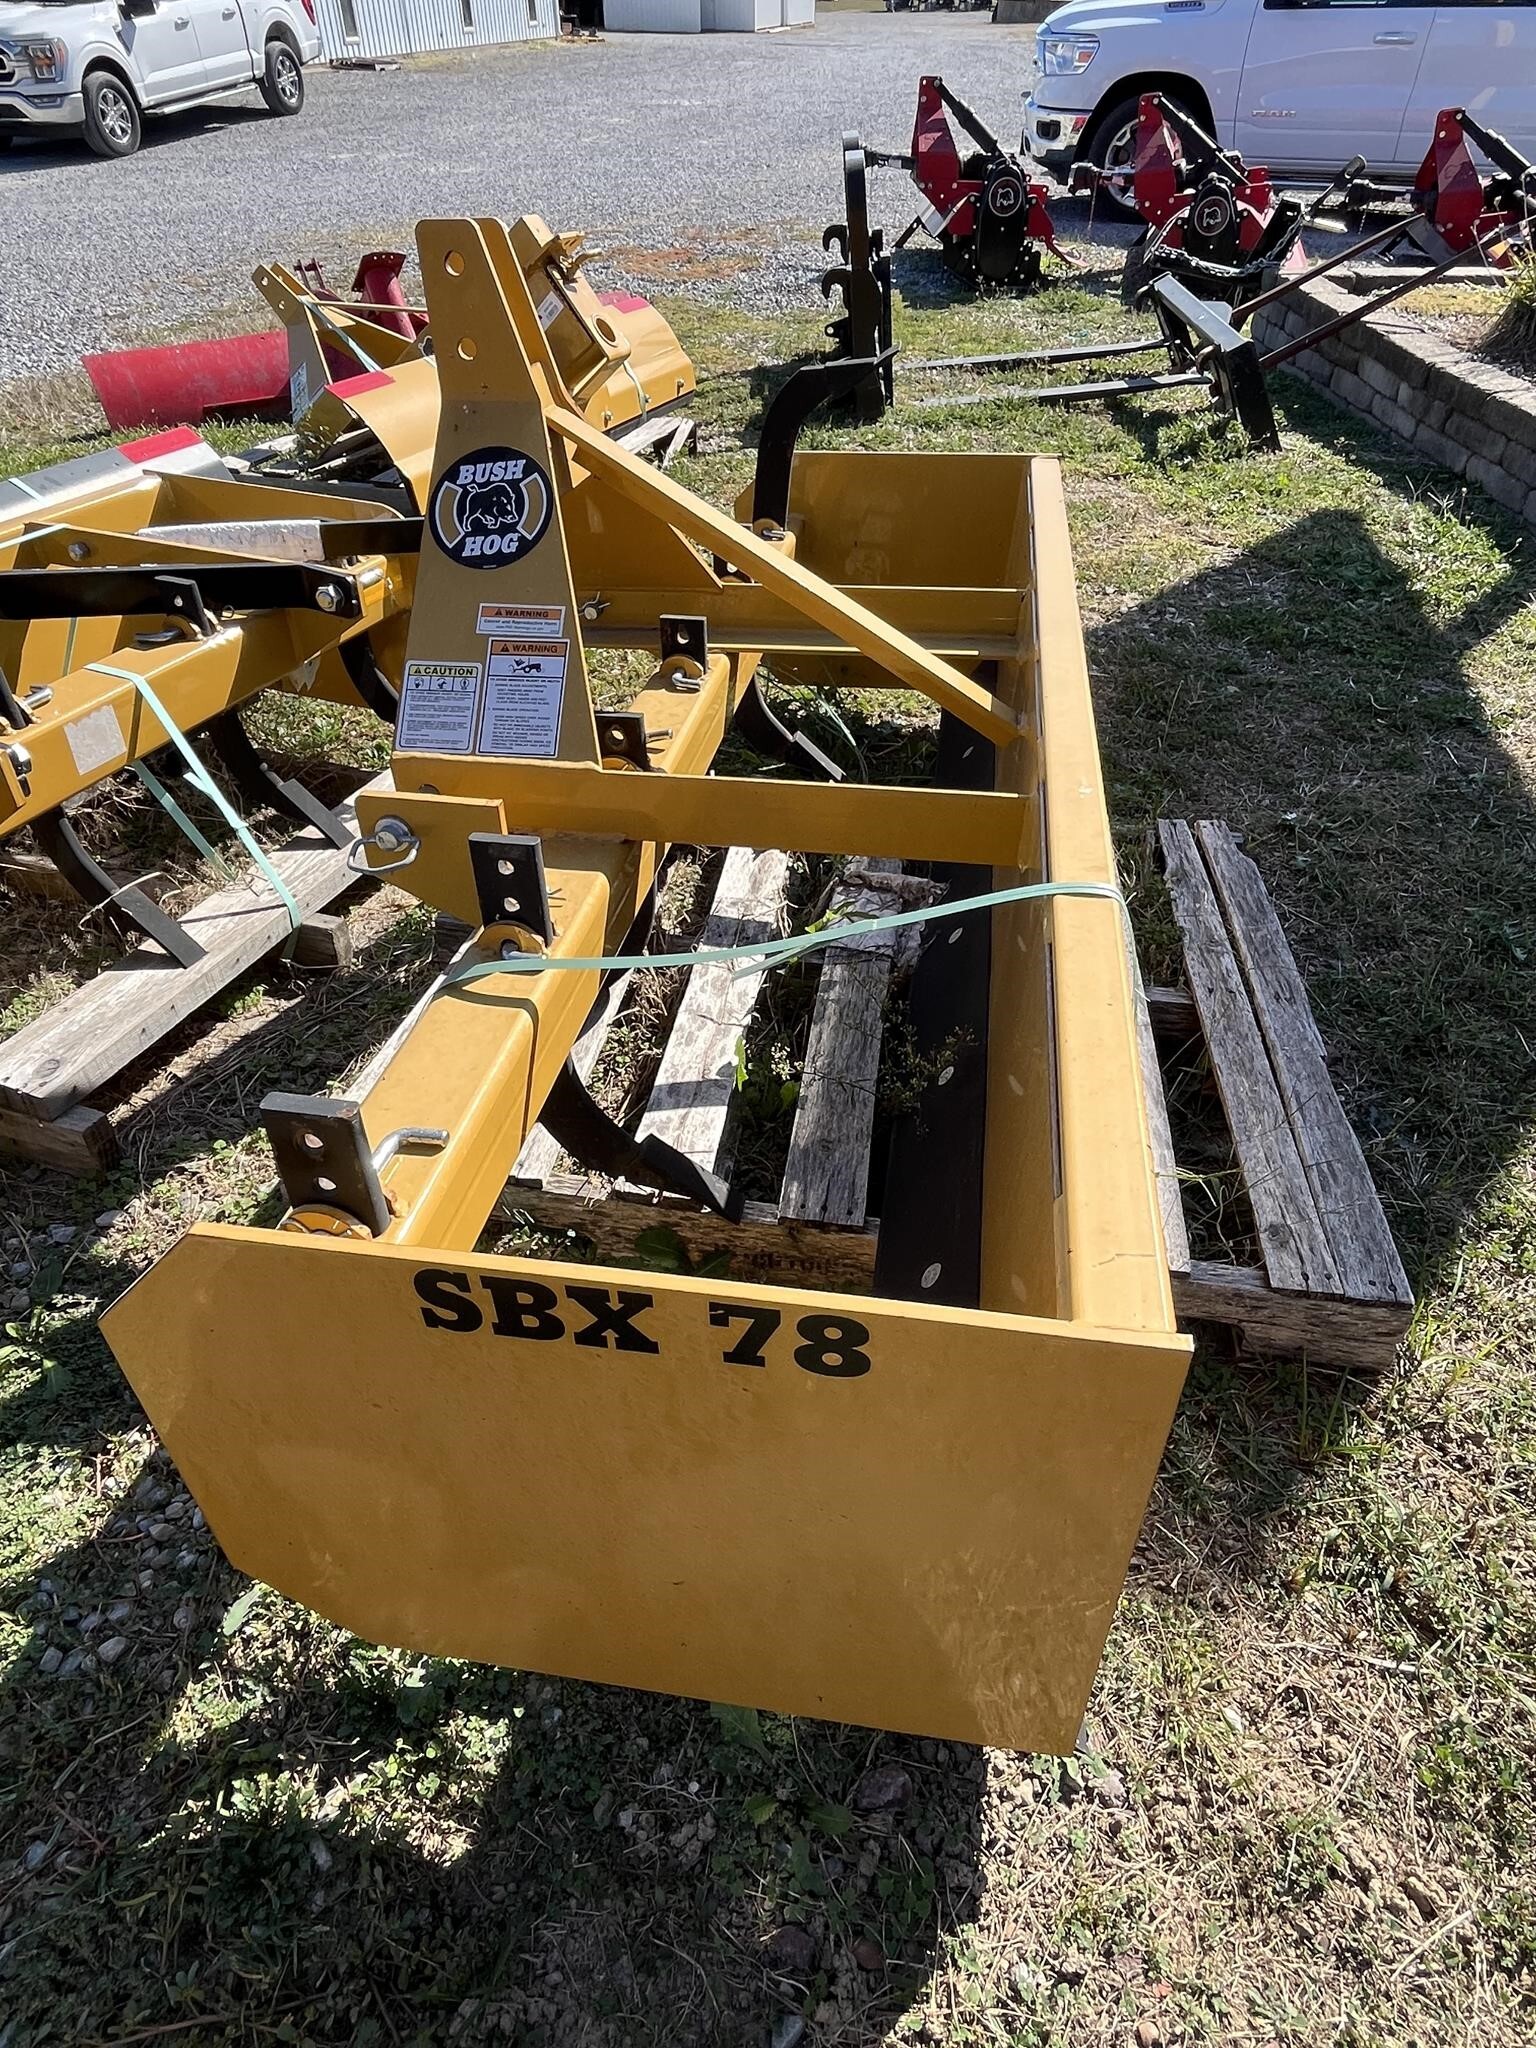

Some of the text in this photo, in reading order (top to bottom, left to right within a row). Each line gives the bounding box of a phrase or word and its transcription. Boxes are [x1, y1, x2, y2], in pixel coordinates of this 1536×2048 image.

[456, 459, 527, 485] BUSH
[461, 533, 519, 557] HOG
[505, 609, 549, 618] WARNING
[513, 644, 558, 653] WARNING
[424, 667, 474, 676] CAUTION
[413, 1267, 872, 1378] SBX 78
